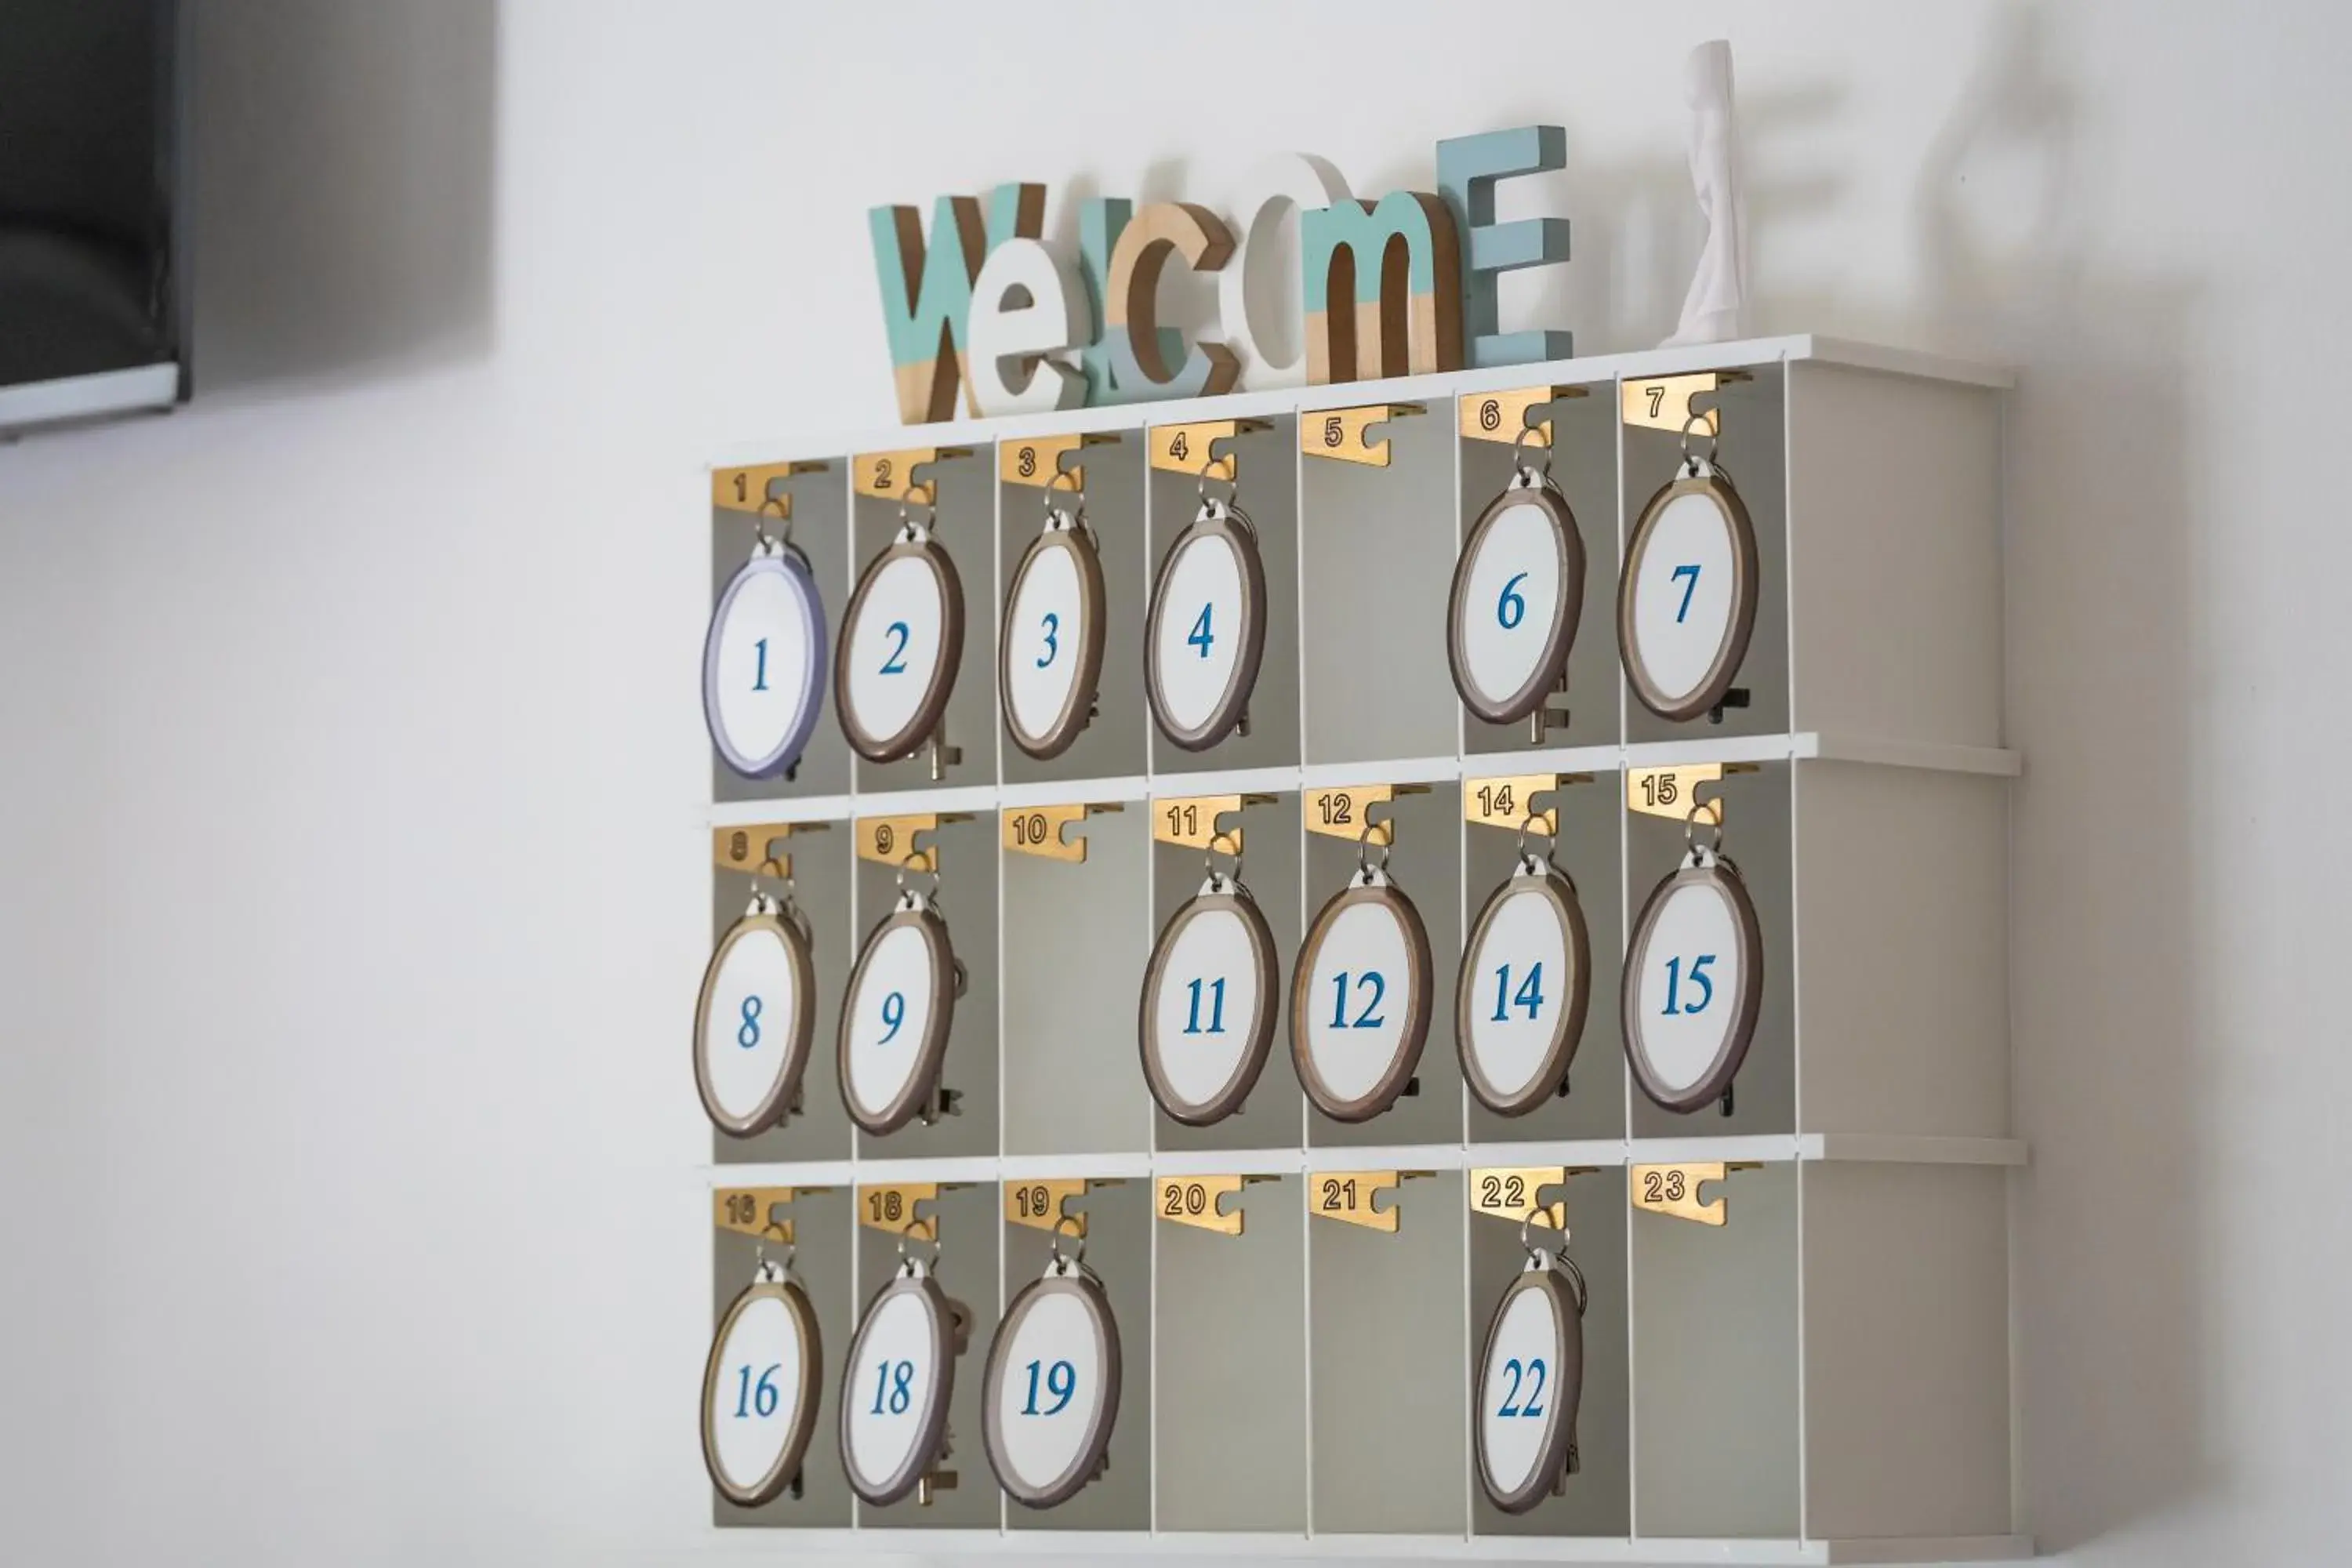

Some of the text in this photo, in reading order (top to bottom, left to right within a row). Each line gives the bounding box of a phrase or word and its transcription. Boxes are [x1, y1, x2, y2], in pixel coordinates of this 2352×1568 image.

[1480, 400, 1501, 430] 6
[1646, 387, 1665, 418] 7
[1169, 432, 1189, 461] 4
[1323, 417, 1343, 448] 5
[873, 459, 891, 488] 2
[1018, 447, 1036, 477] 3
[733, 472, 746, 503] 1
[1497, 572, 1529, 630] 6
[1669, 564, 1703, 624] 7
[1036, 612, 1060, 669] 3
[1187, 601, 1214, 659] 4
[879, 620, 910, 675] 2
[751, 638, 769, 691] 1
[1477, 785, 1514, 817] 14
[1641, 774, 1677, 806] 15
[1167, 804, 1197, 837] 11
[1318, 793, 1352, 825] 12
[875, 824, 894, 855] 9
[1013, 814, 1047, 845] 10
[729, 830, 748, 862] 8
[1328, 971, 1388, 1029] 12
[1490, 961, 1545, 1022] 14
[1661, 953, 1717, 1017] 15
[737, 994, 763, 1049] 8
[877, 991, 906, 1046] 9
[1182, 977, 1227, 1035] 11
[1016, 1185, 1049, 1218] 19
[1164, 1184, 1206, 1216] 20
[1323, 1179, 1356, 1210] 21
[1481, 1175, 1524, 1207] 22
[1644, 1171, 1685, 1203] 23
[868, 1191, 902, 1221] 18
[733, 1363, 782, 1419] 16
[870, 1360, 914, 1417] 18
[1019, 1359, 1077, 1417] 19
[1497, 1357, 1548, 1418] 22
